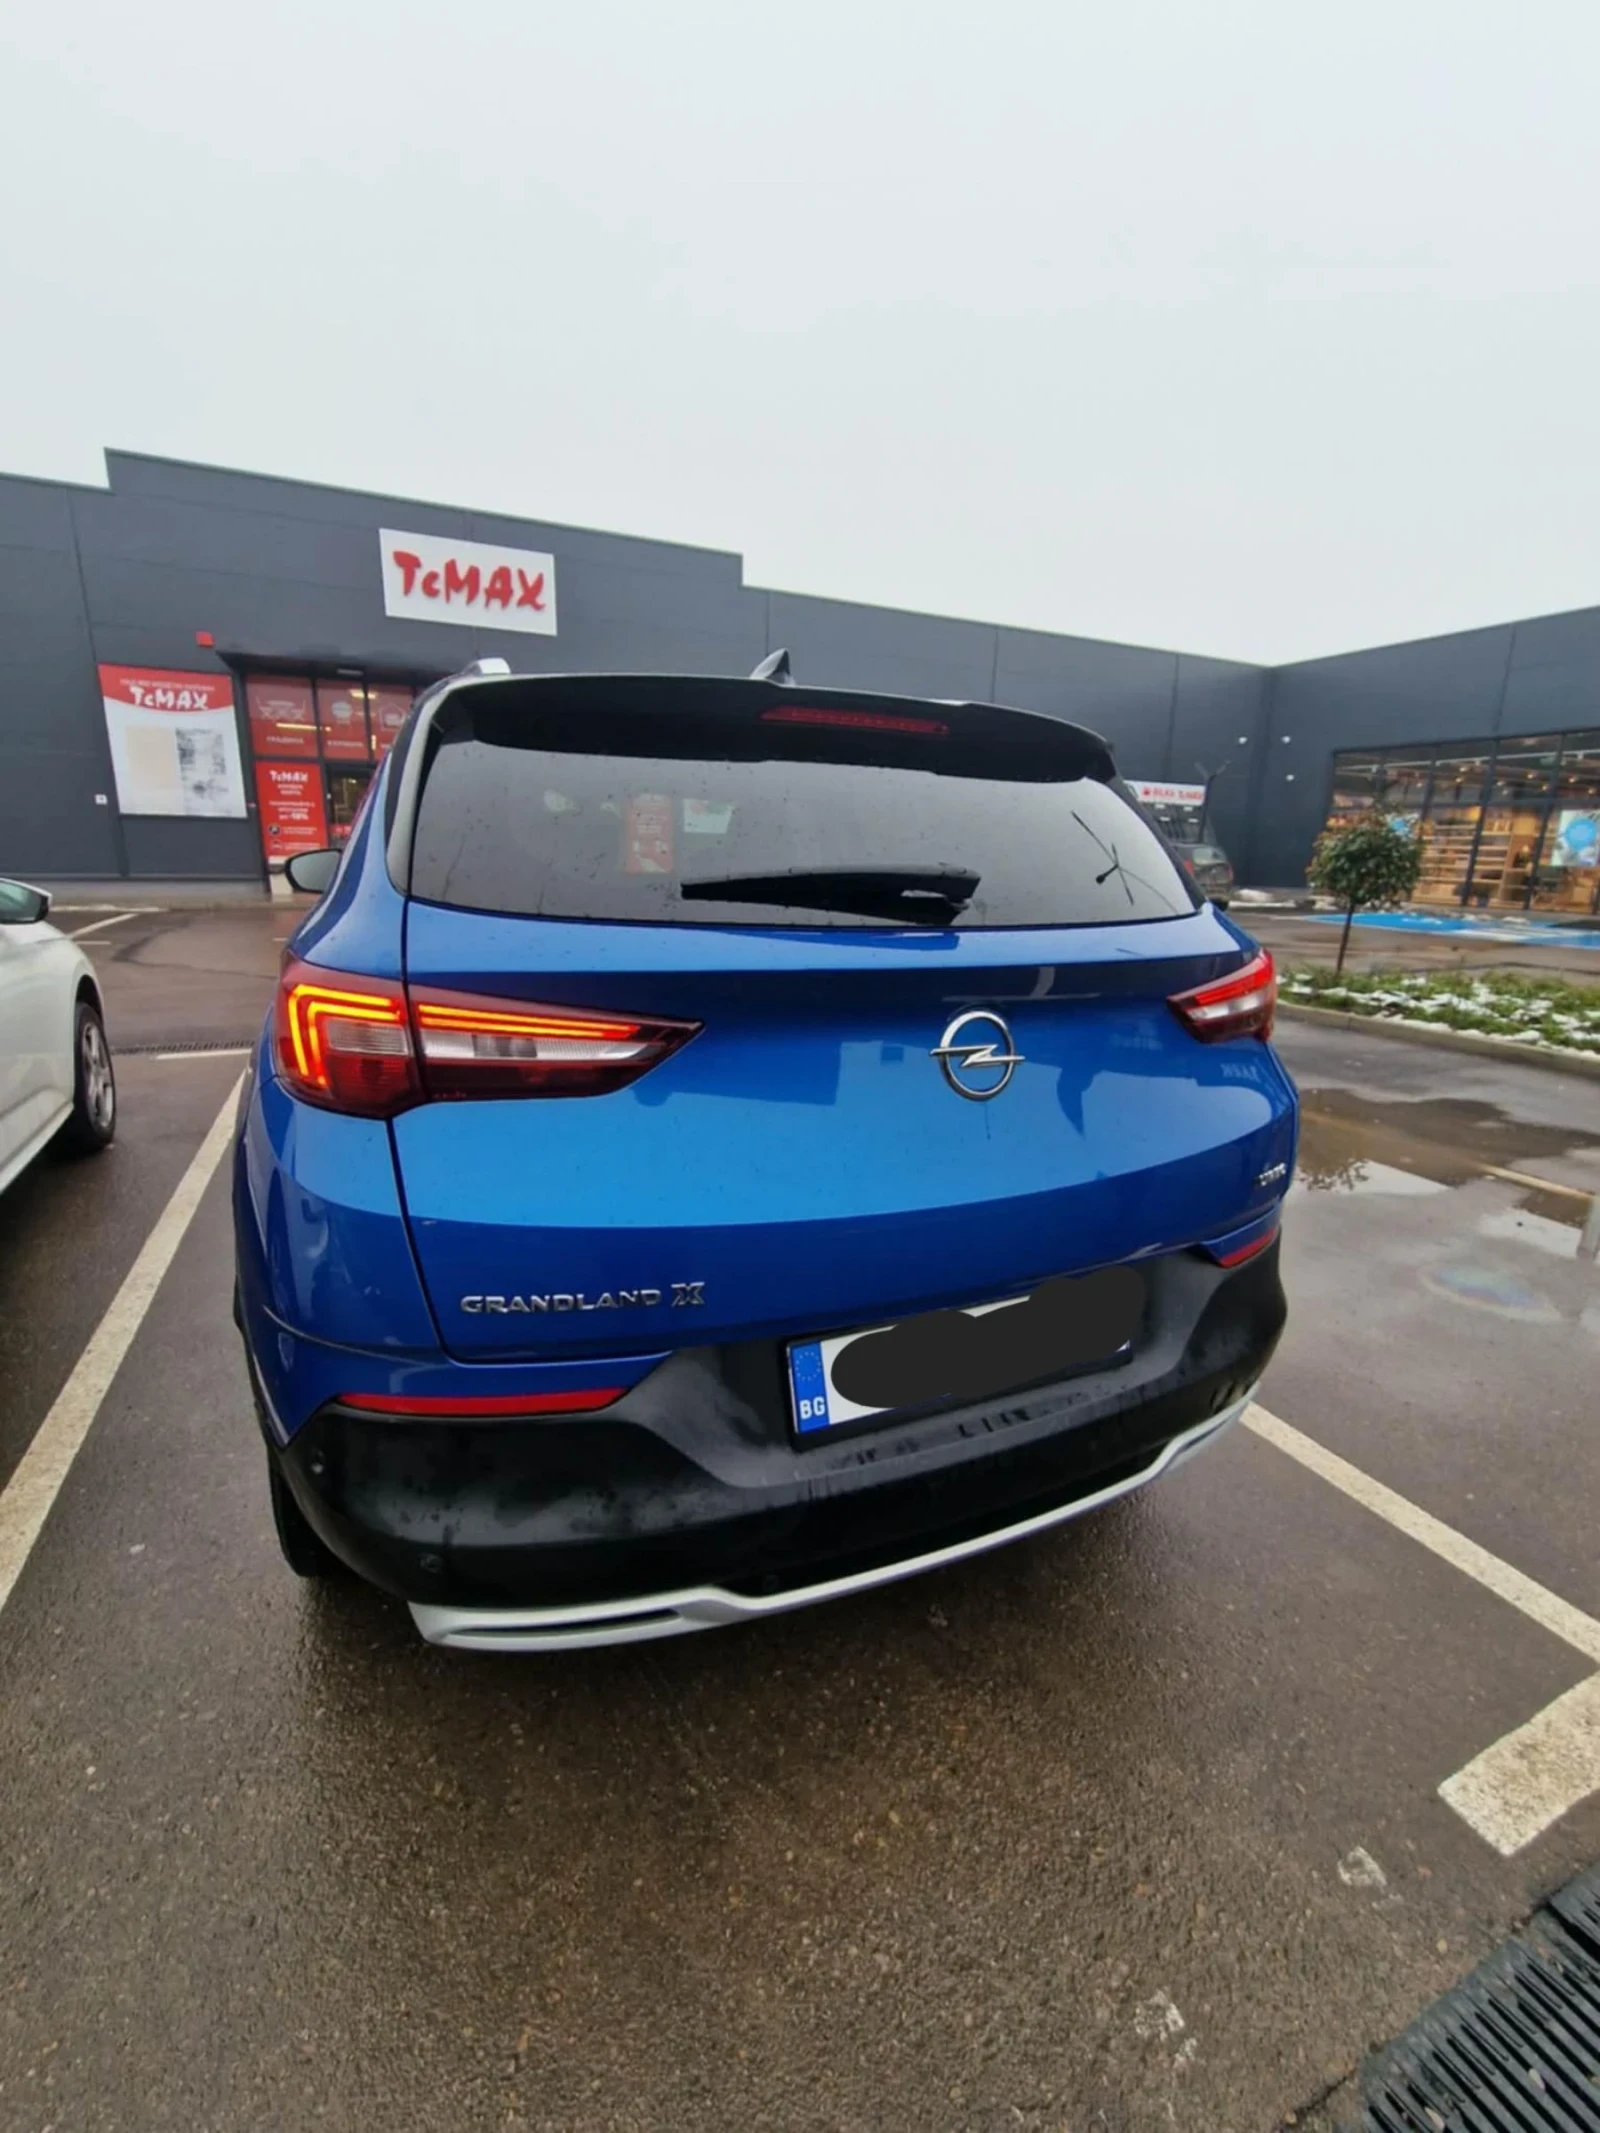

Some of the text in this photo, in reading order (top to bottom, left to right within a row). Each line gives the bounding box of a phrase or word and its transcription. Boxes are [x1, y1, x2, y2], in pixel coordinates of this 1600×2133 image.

[460, 1281, 706, 1314] GRANDLAND X
[799, 1396, 826, 1420] BG
